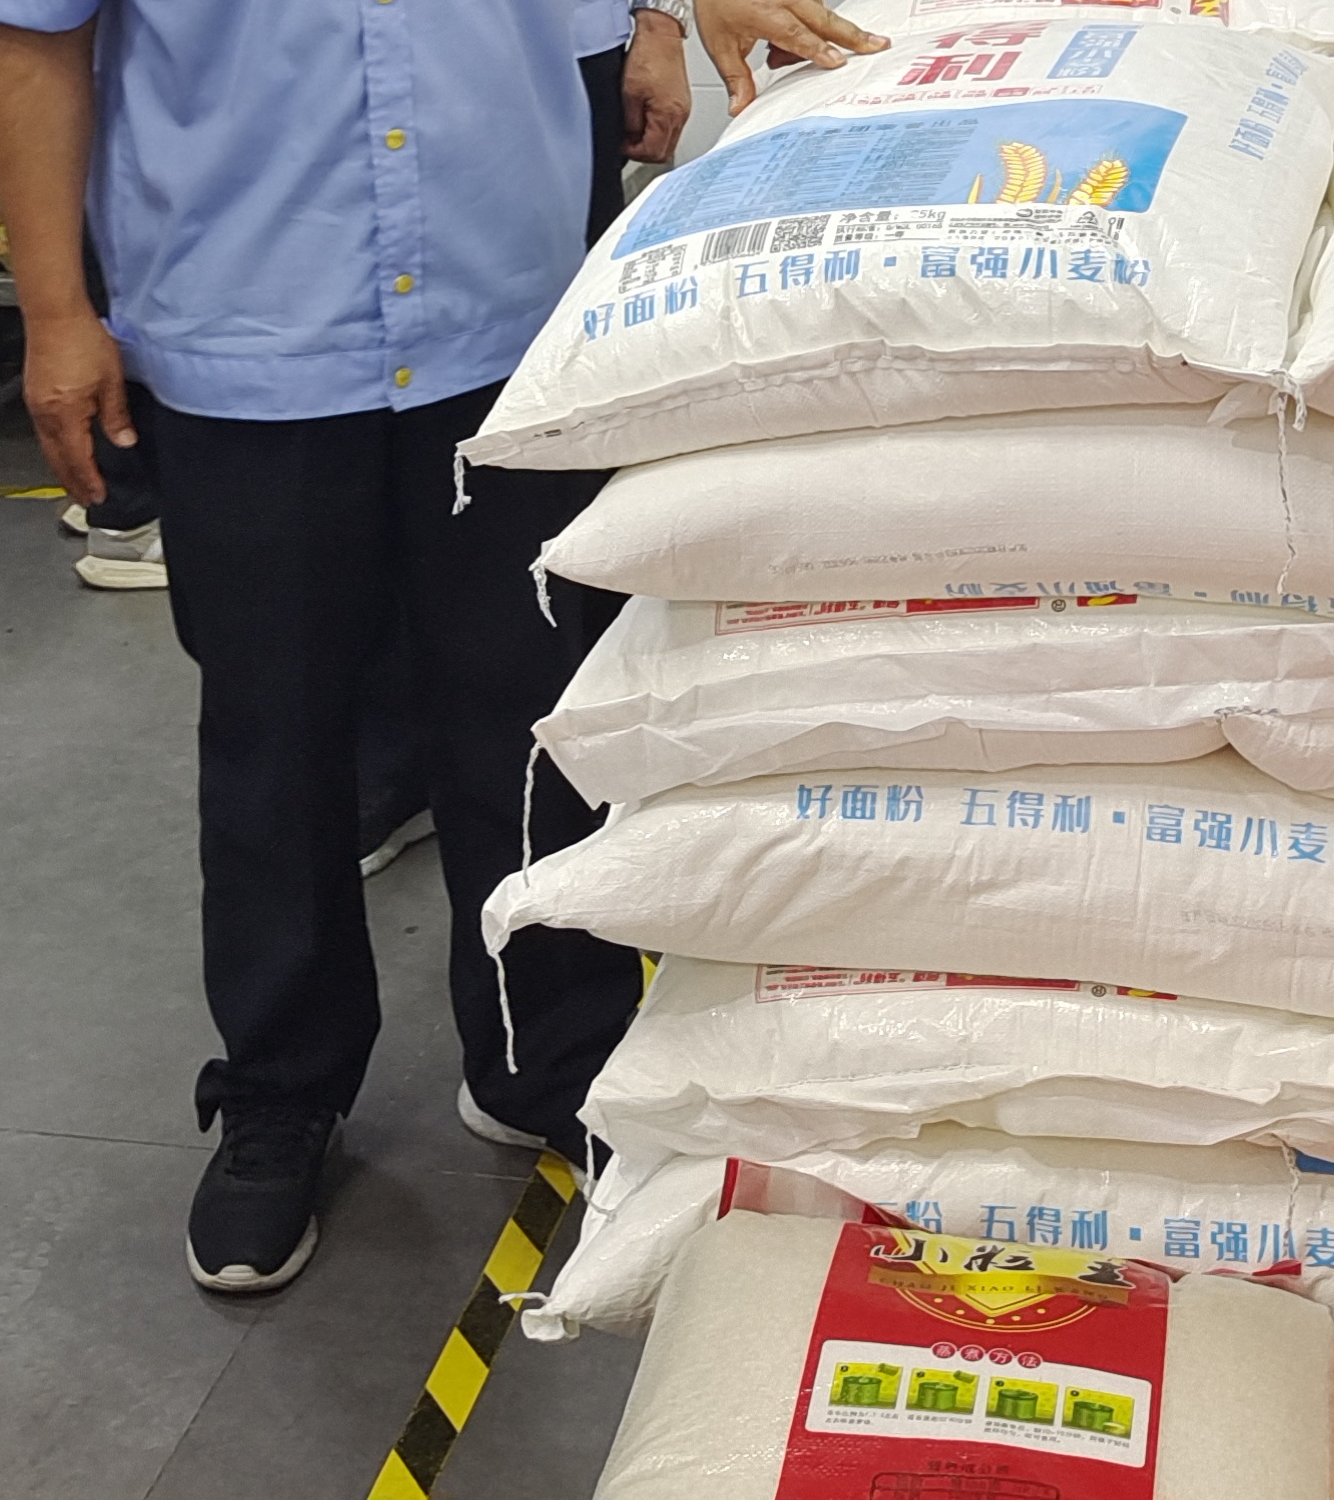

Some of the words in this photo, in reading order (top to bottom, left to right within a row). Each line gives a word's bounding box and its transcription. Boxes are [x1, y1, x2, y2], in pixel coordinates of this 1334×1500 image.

[582, 274, 700, 342] 好面粉
[795, 781, 924, 828] 好面粉
[967, 1284, 1015, 1293] XIAO
[1025, 1284, 1042, 1293] LI
